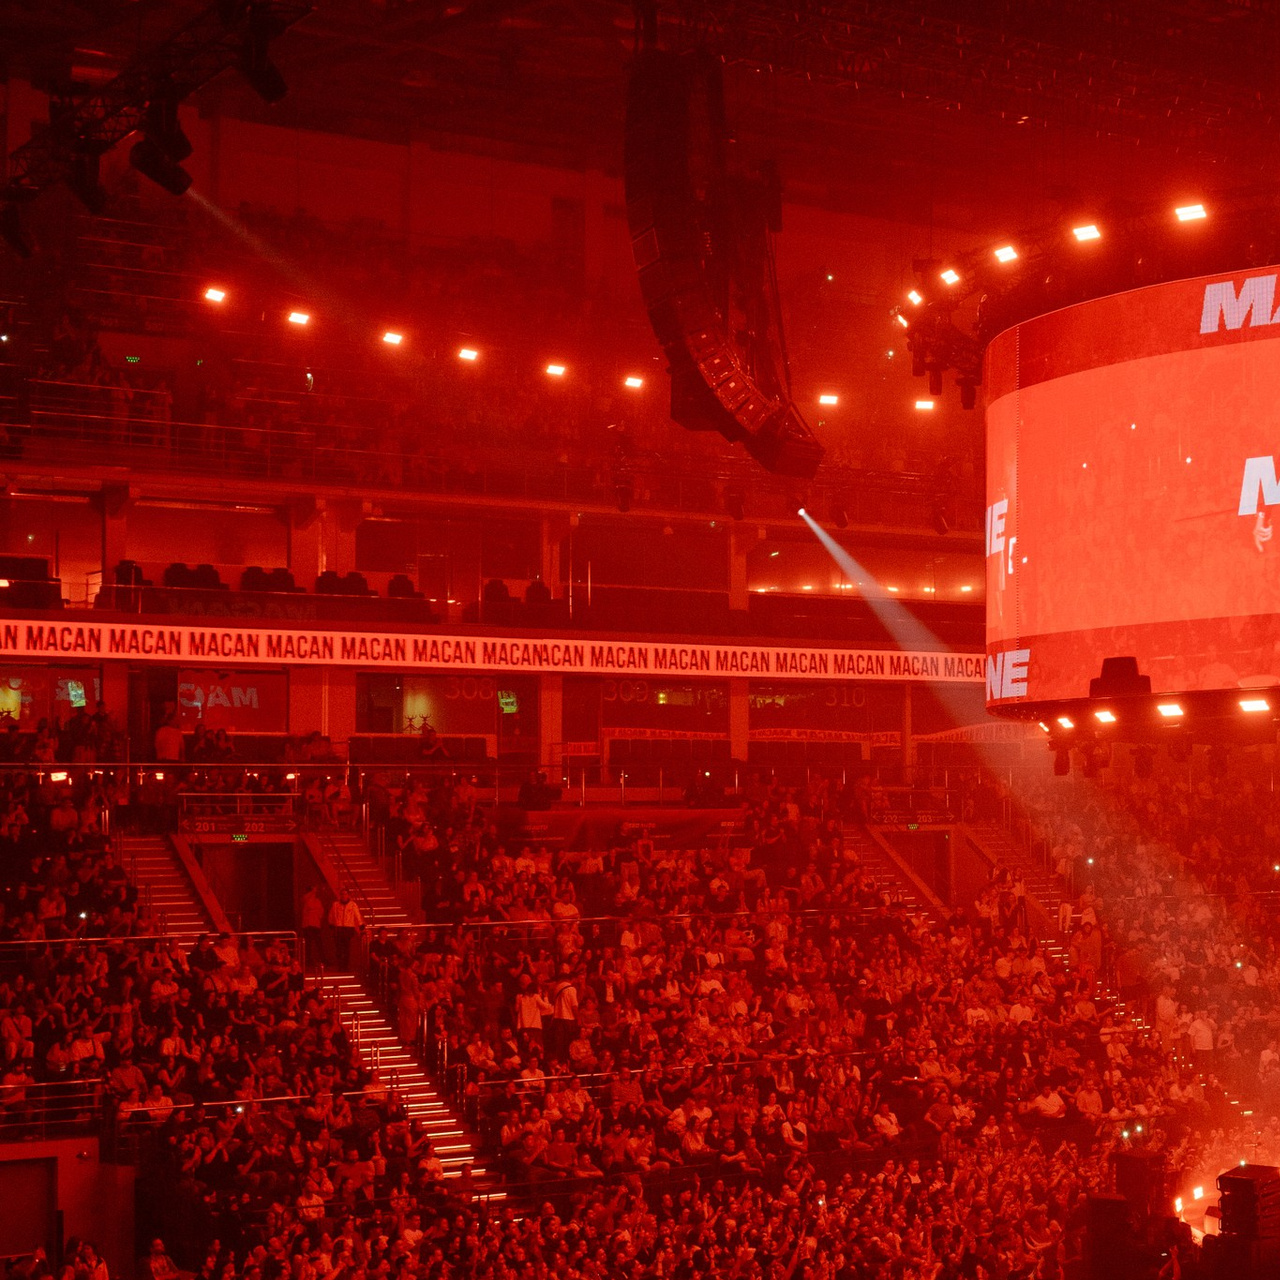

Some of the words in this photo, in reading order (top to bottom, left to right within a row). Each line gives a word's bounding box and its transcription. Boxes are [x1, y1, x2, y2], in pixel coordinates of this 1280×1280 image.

[26, 626, 101, 652] MACAN
[109, 629, 181, 655] MACAN
[189, 632, 259, 657] MACAN
[266, 634, 334, 659] MACAN
[341, 637, 406, 661] MACAN
[413, 639, 476, 664] MACAN
[591, 646, 648, 669] MACAN
[654, 648, 710, 670] MACAN
[716, 650, 770, 672] MACAN
[776, 652, 828, 674] MACAN
[834, 654, 884, 675] MACAN
[890, 655, 938, 676] MACAN
[445, 677, 495, 700] 308
[824, 687, 867, 708] 310
[195, 822, 216, 832] 201
[244, 822, 265, 832] 202
